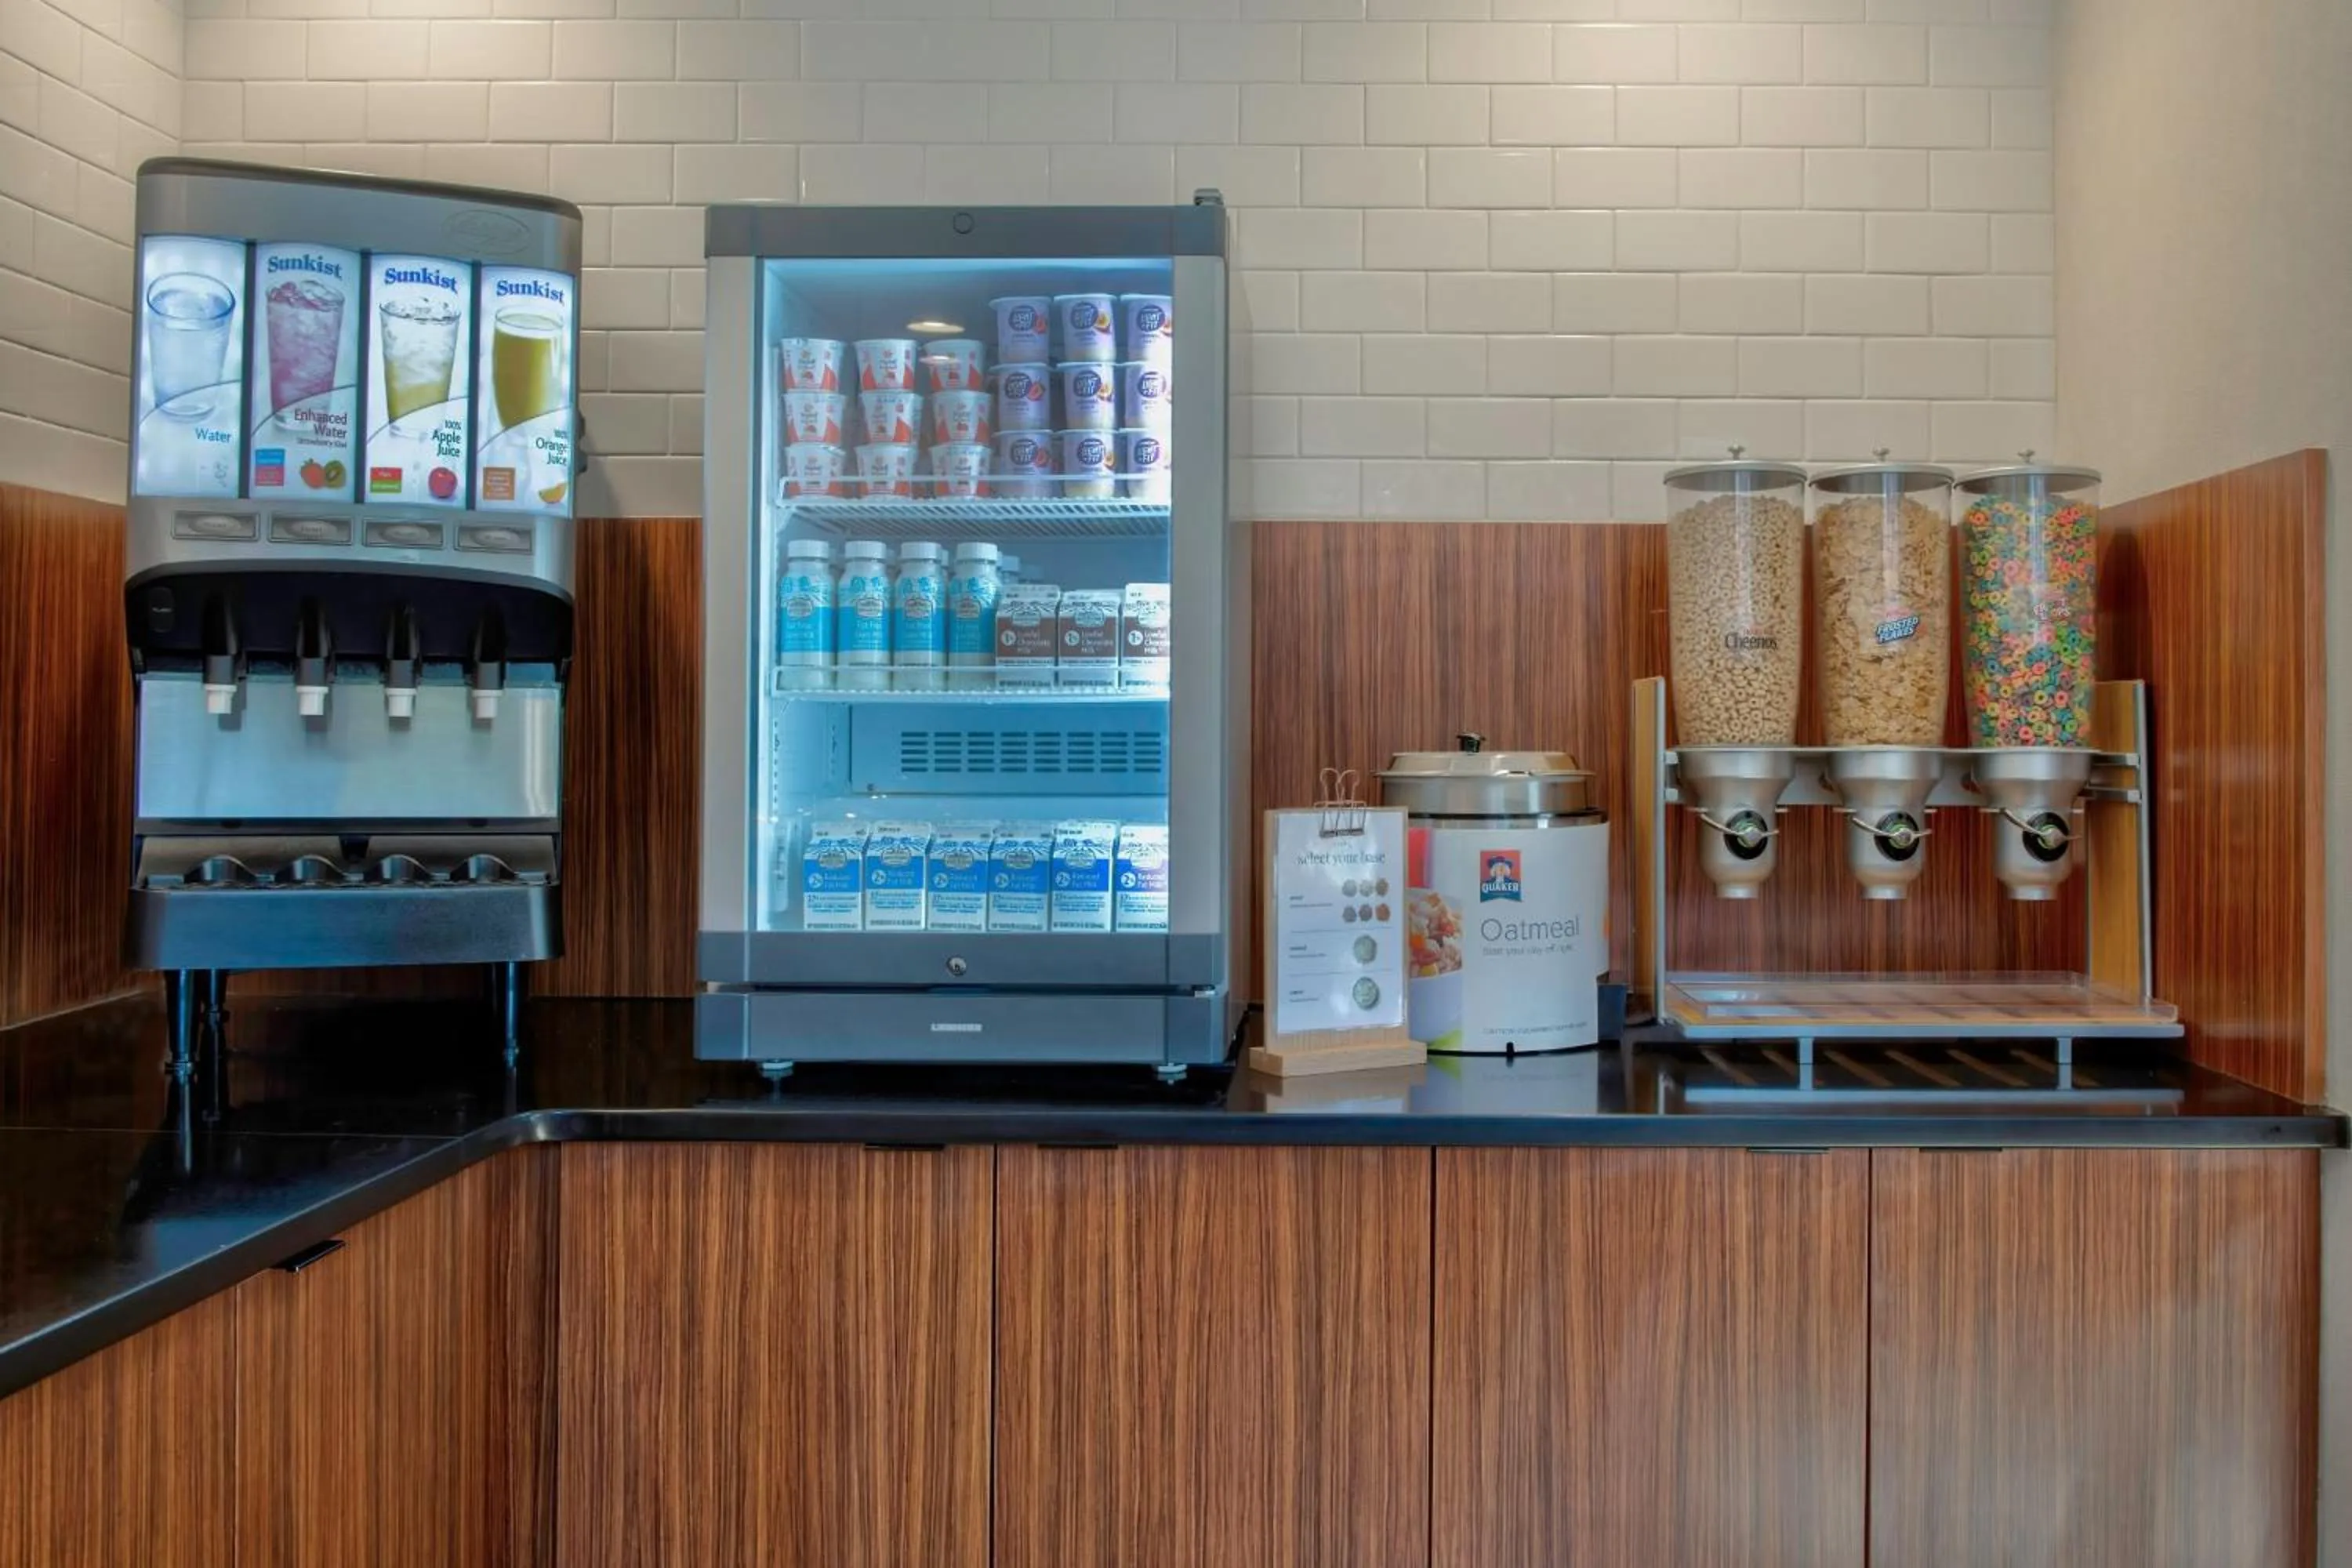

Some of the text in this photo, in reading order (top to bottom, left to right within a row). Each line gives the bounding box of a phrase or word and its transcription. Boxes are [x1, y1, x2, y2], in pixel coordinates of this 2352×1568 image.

[267, 254, 343, 281] Sunkist
[384, 268, 457, 294] Sunkist
[496, 280, 564, 306] Sunkist
[294, 408, 347, 425] Enhanced
[195, 428, 231, 443] Water
[314, 423, 347, 438] Water
[432, 430, 461, 446] Apple
[437, 444, 460, 457] Juice
[535, 437, 568, 455] Orange
[546, 453, 567, 466] Juice
[1481, 882, 1519, 893] QUAKER
[1481, 913, 1580, 942] Oatmeal
